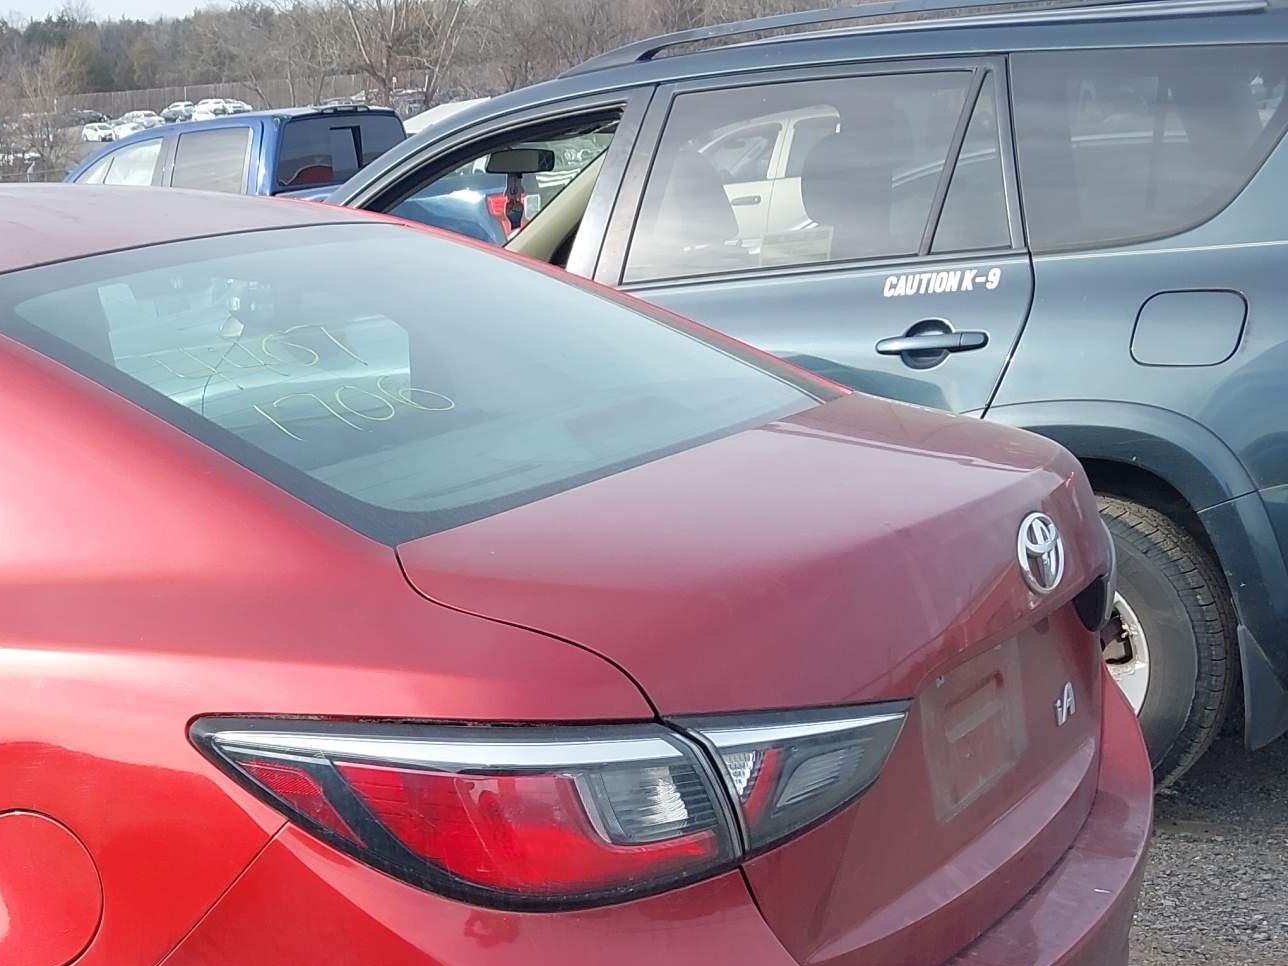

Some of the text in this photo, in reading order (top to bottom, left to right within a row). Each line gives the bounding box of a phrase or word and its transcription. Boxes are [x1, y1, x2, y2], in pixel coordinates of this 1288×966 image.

[883, 267, 1001, 297] CAUTION K-9
[253, 375, 456, 442] 1706
